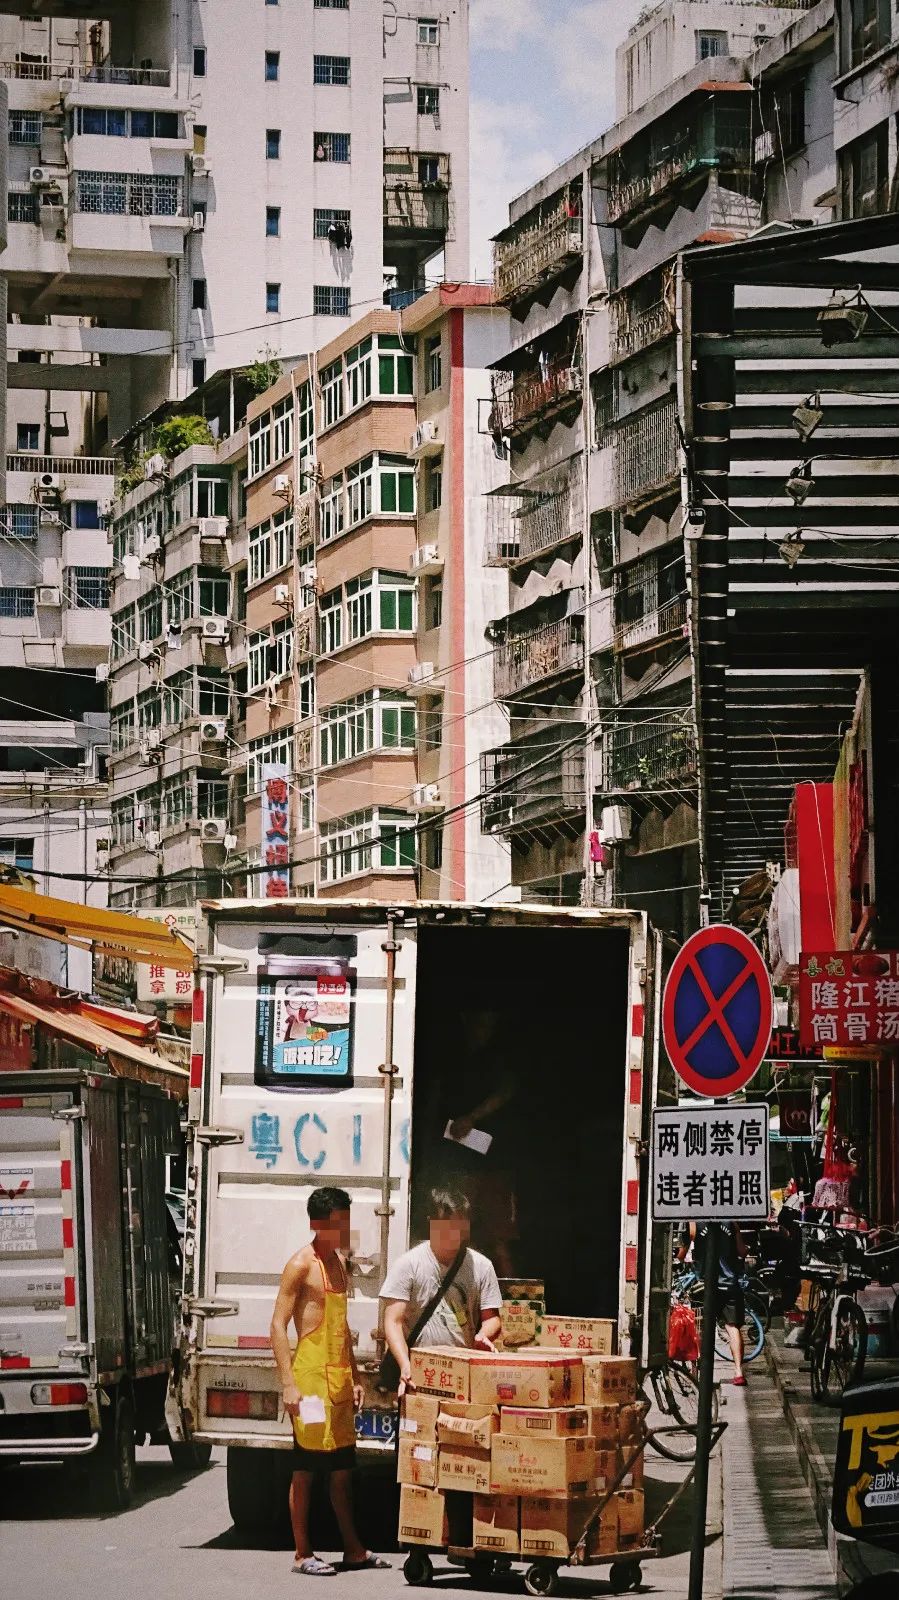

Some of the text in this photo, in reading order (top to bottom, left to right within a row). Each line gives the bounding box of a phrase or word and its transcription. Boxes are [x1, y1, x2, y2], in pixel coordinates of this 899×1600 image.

[658, 1119, 763, 1158] 两侧禁停
[656, 1171, 763, 1207] 违者拍照
